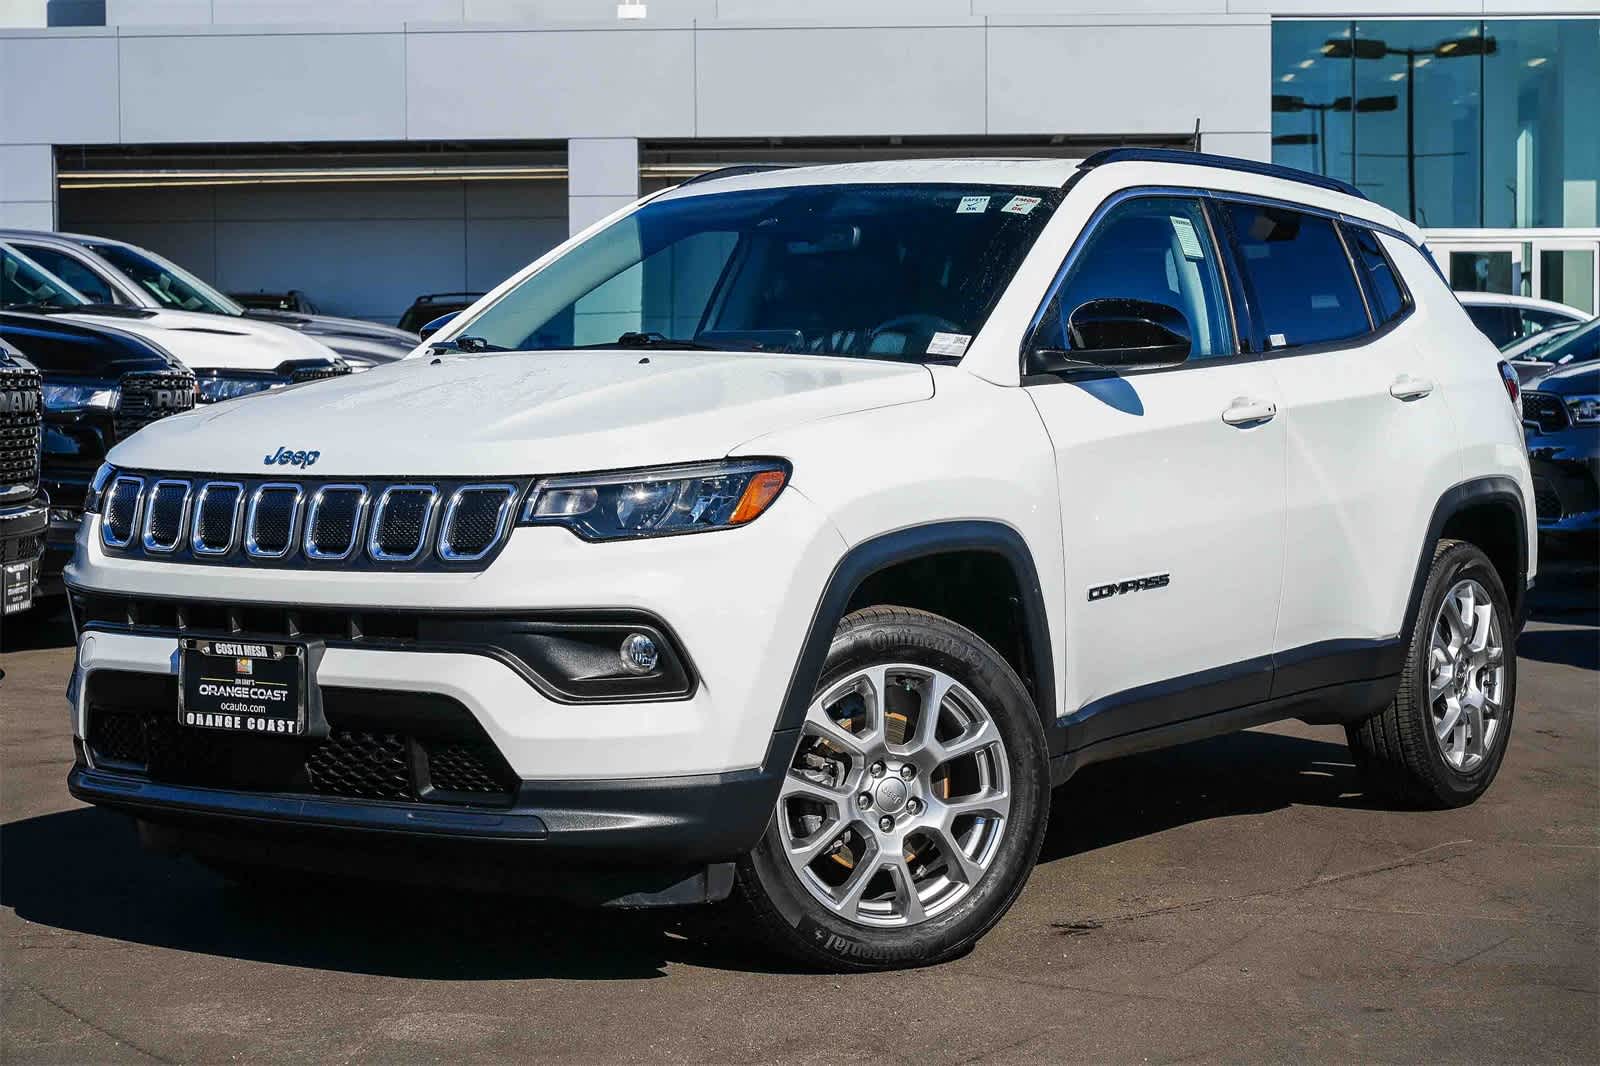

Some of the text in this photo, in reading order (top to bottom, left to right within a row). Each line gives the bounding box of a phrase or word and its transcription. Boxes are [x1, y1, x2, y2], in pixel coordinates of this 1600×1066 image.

[263, 446, 320, 469] Jeep
[1088, 573, 1170, 602] COMPASS
[215, 643, 268, 657] COSTA MESA
[199, 684, 288, 701] ORANGE COAST
[220, 702, 266, 713] ocauto.com
[186, 712, 295, 733] ORANGE COAST
